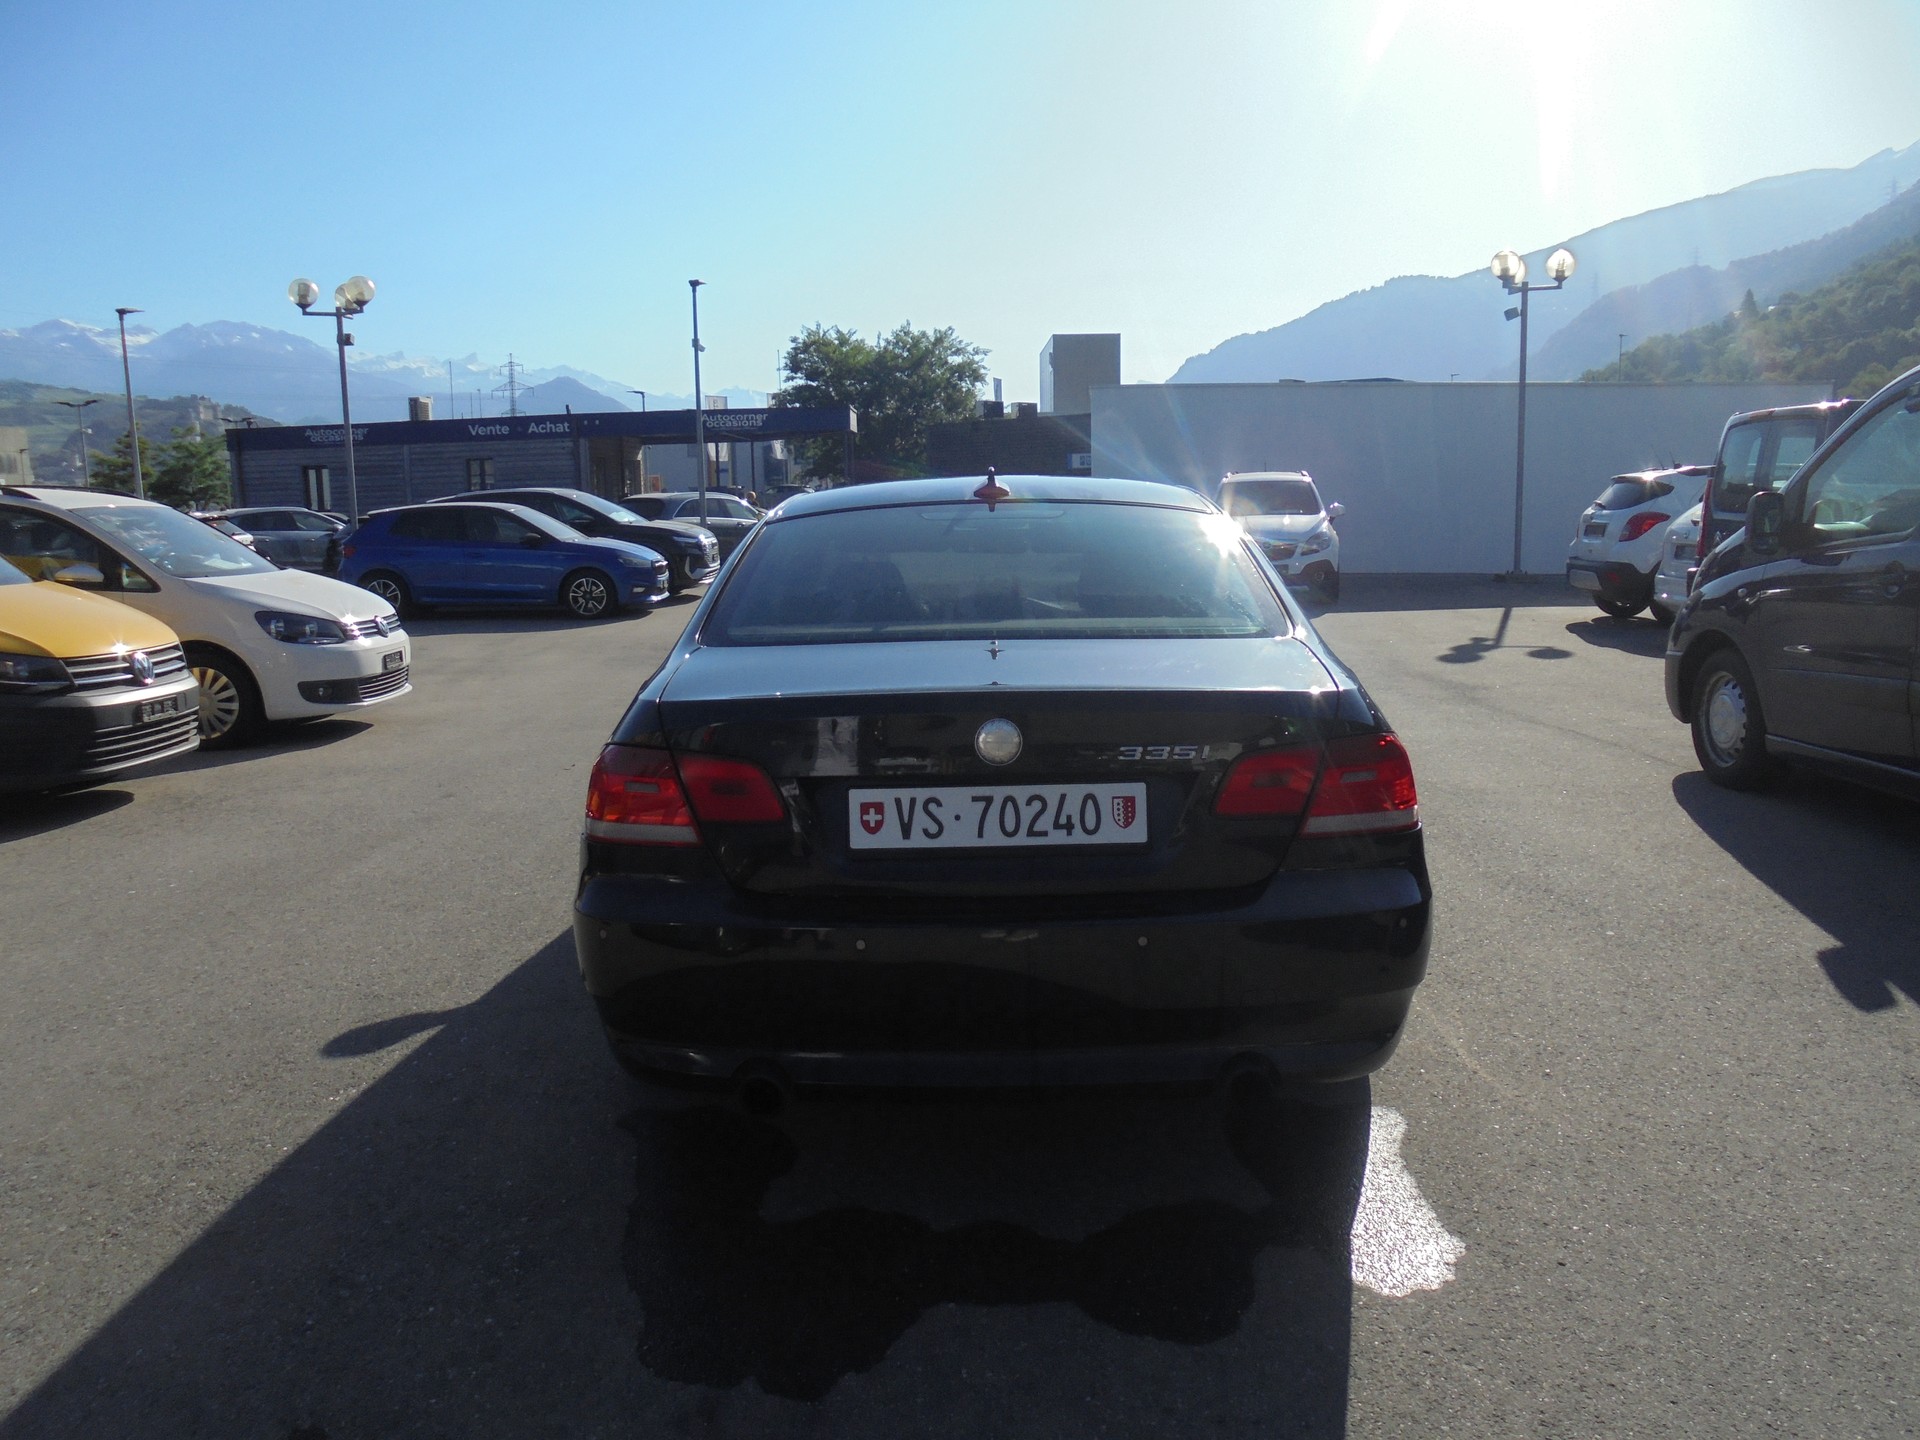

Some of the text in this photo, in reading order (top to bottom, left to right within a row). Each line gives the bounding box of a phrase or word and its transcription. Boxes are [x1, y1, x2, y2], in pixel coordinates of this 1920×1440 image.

[706, 420, 763, 428] occasions
[304, 428, 368, 437] Autoconer
[468, 421, 570, 436] Vente Achat
[310, 434, 364, 442] occasins
